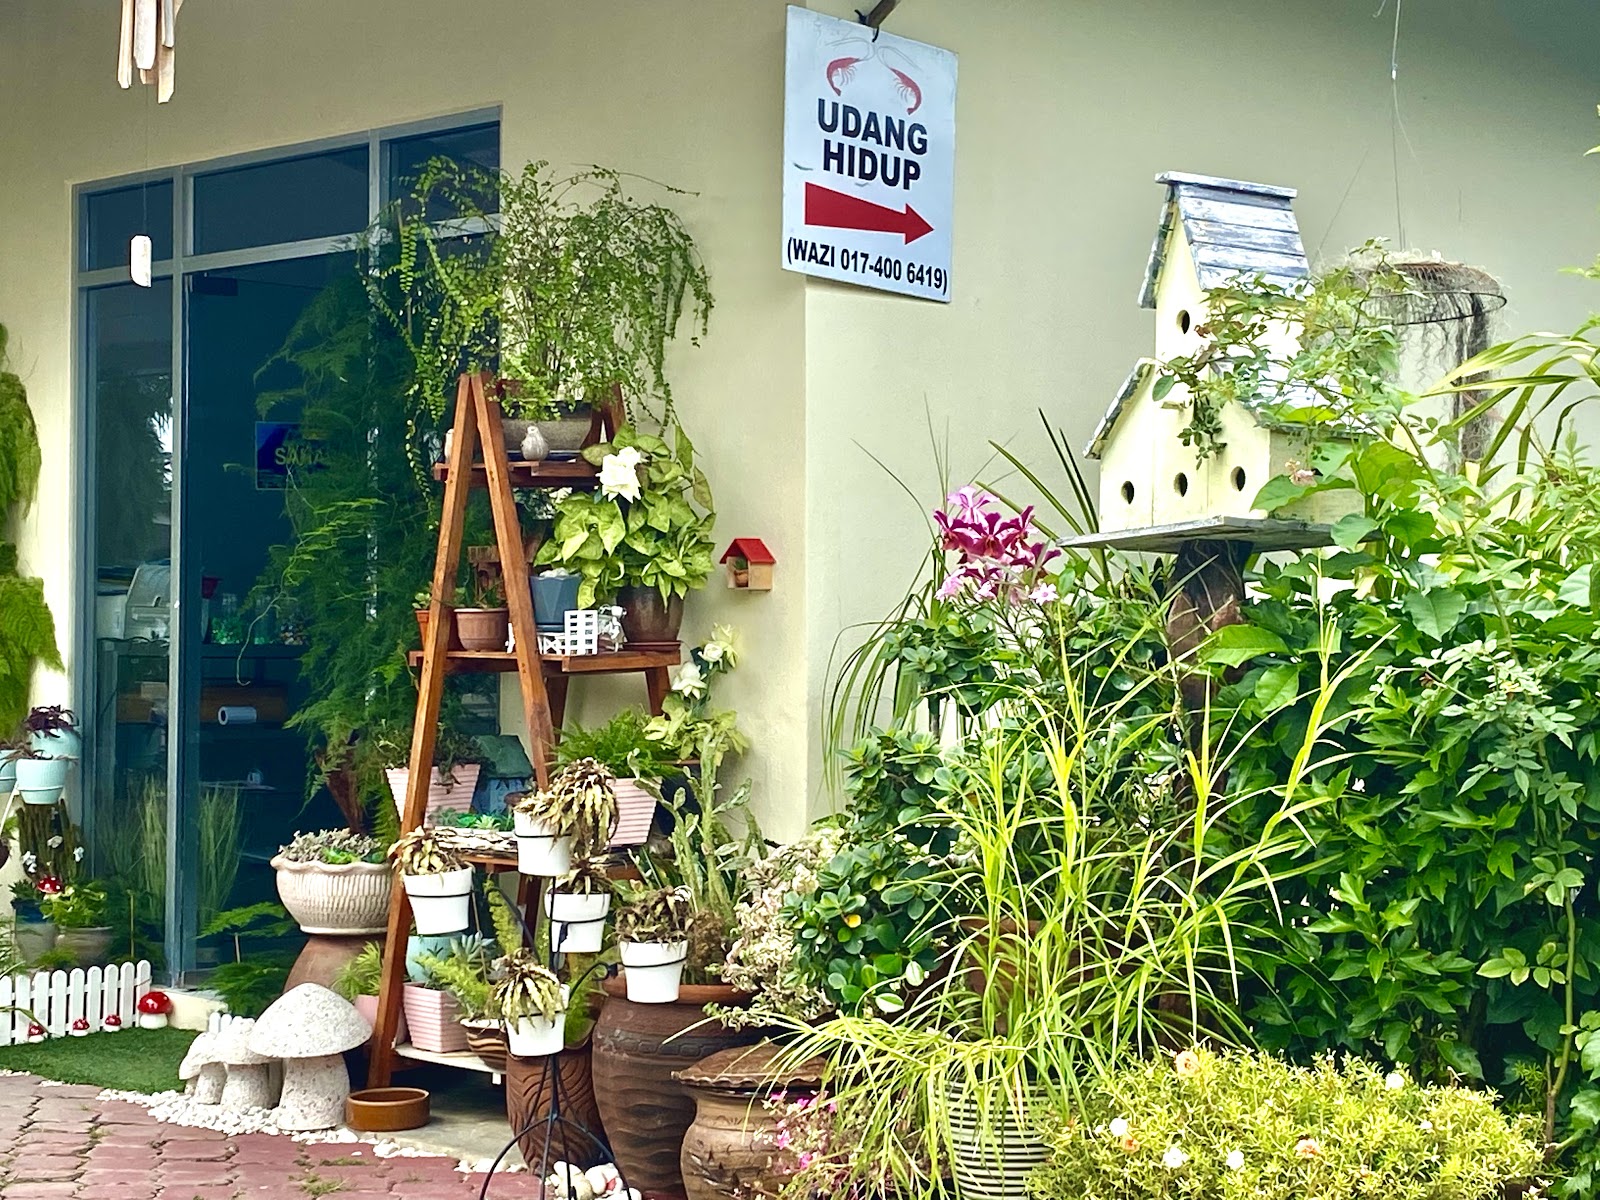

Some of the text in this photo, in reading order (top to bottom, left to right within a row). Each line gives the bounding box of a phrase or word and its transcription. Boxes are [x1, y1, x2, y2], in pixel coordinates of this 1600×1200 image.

[818, 98, 928, 155] UDANG
[823, 139, 921, 190] HIDUP
[787, 237, 948, 295] (WAZI 017-400 6419)
